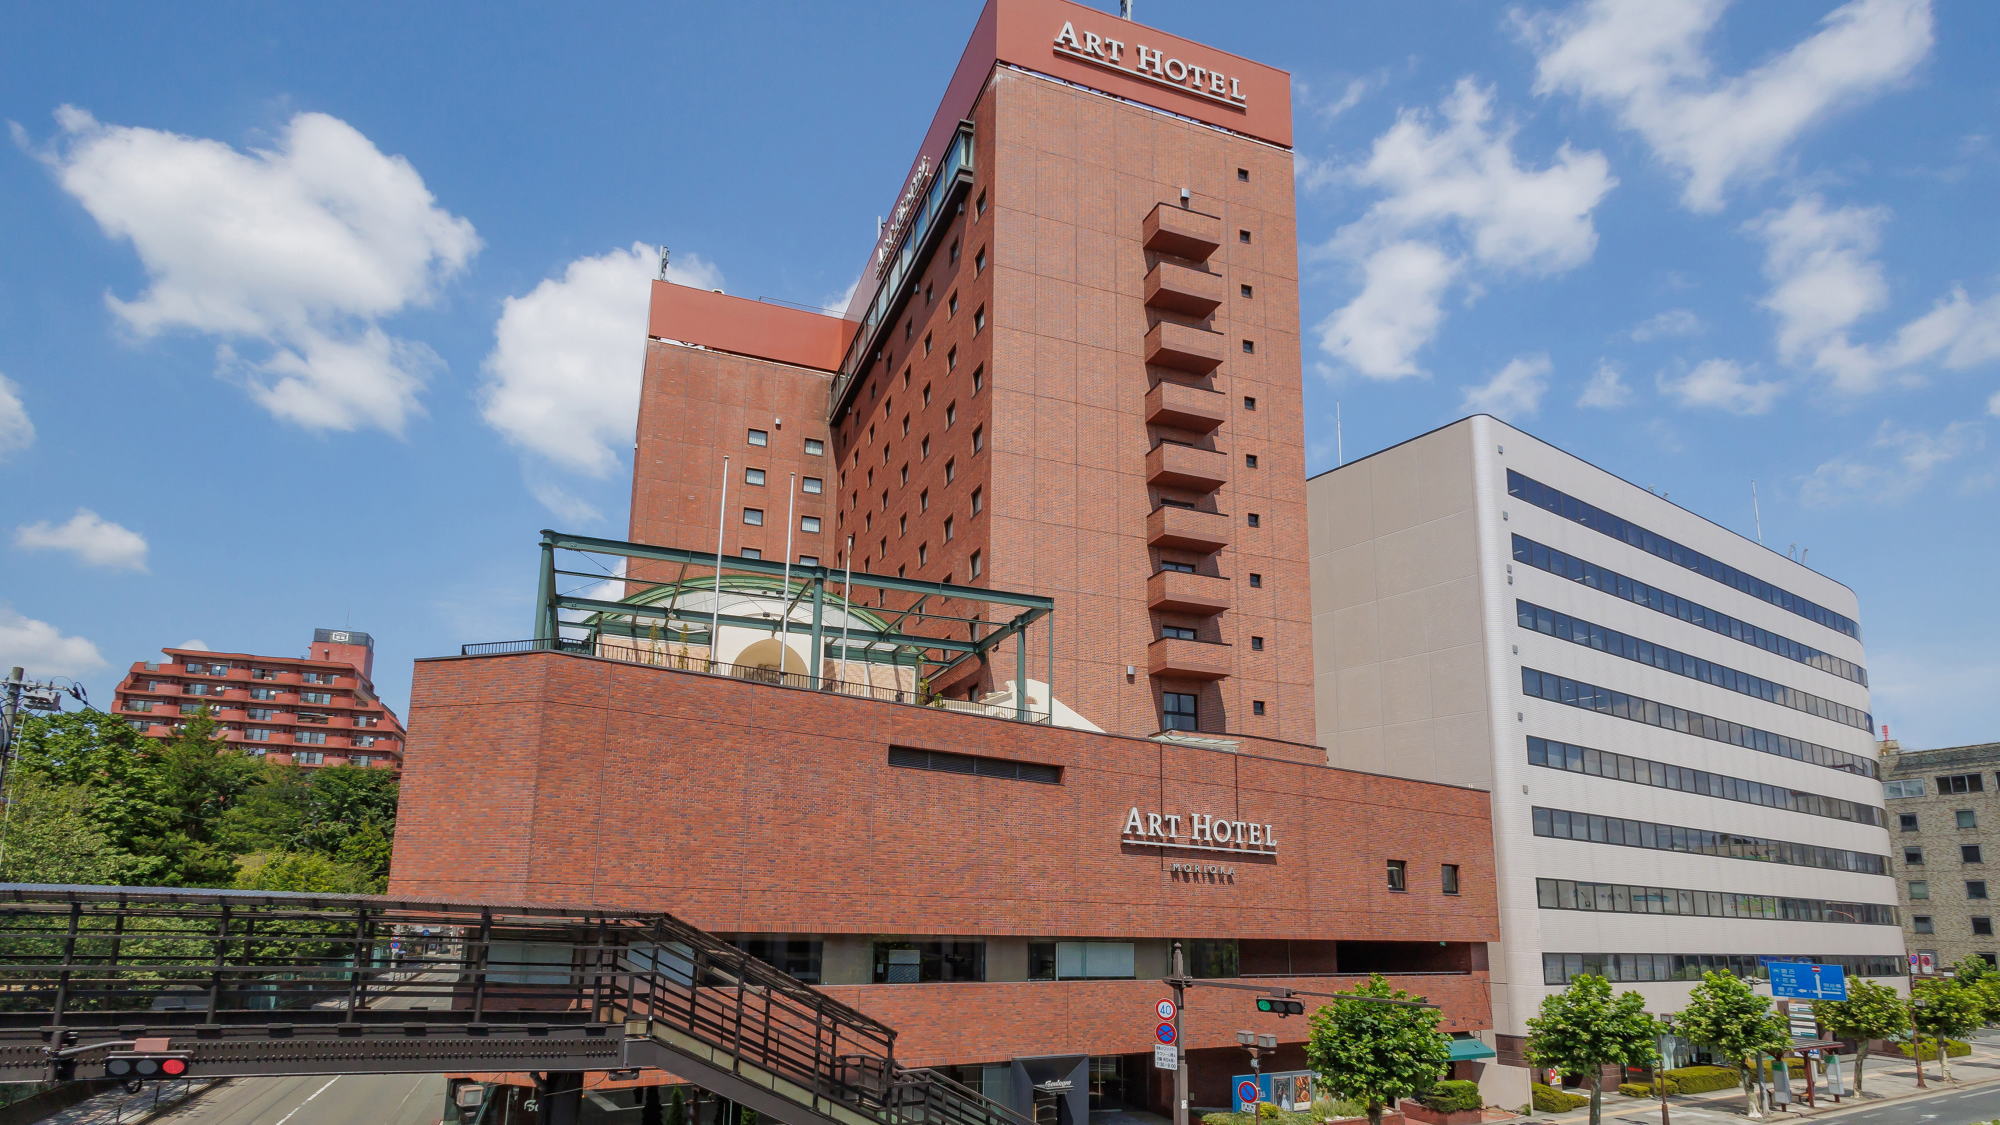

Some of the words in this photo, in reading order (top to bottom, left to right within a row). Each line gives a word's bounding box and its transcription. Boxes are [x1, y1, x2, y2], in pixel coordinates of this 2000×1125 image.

[1054, 20, 1124, 61] ART
[1137, 44, 1247, 100] HOTEL
[1123, 807, 1181, 838] ART
[1191, 813, 1278, 846] HOTEL
[1172, 863, 1235, 875] MORIOKA
[1160, 1005, 1171, 1015] 40
